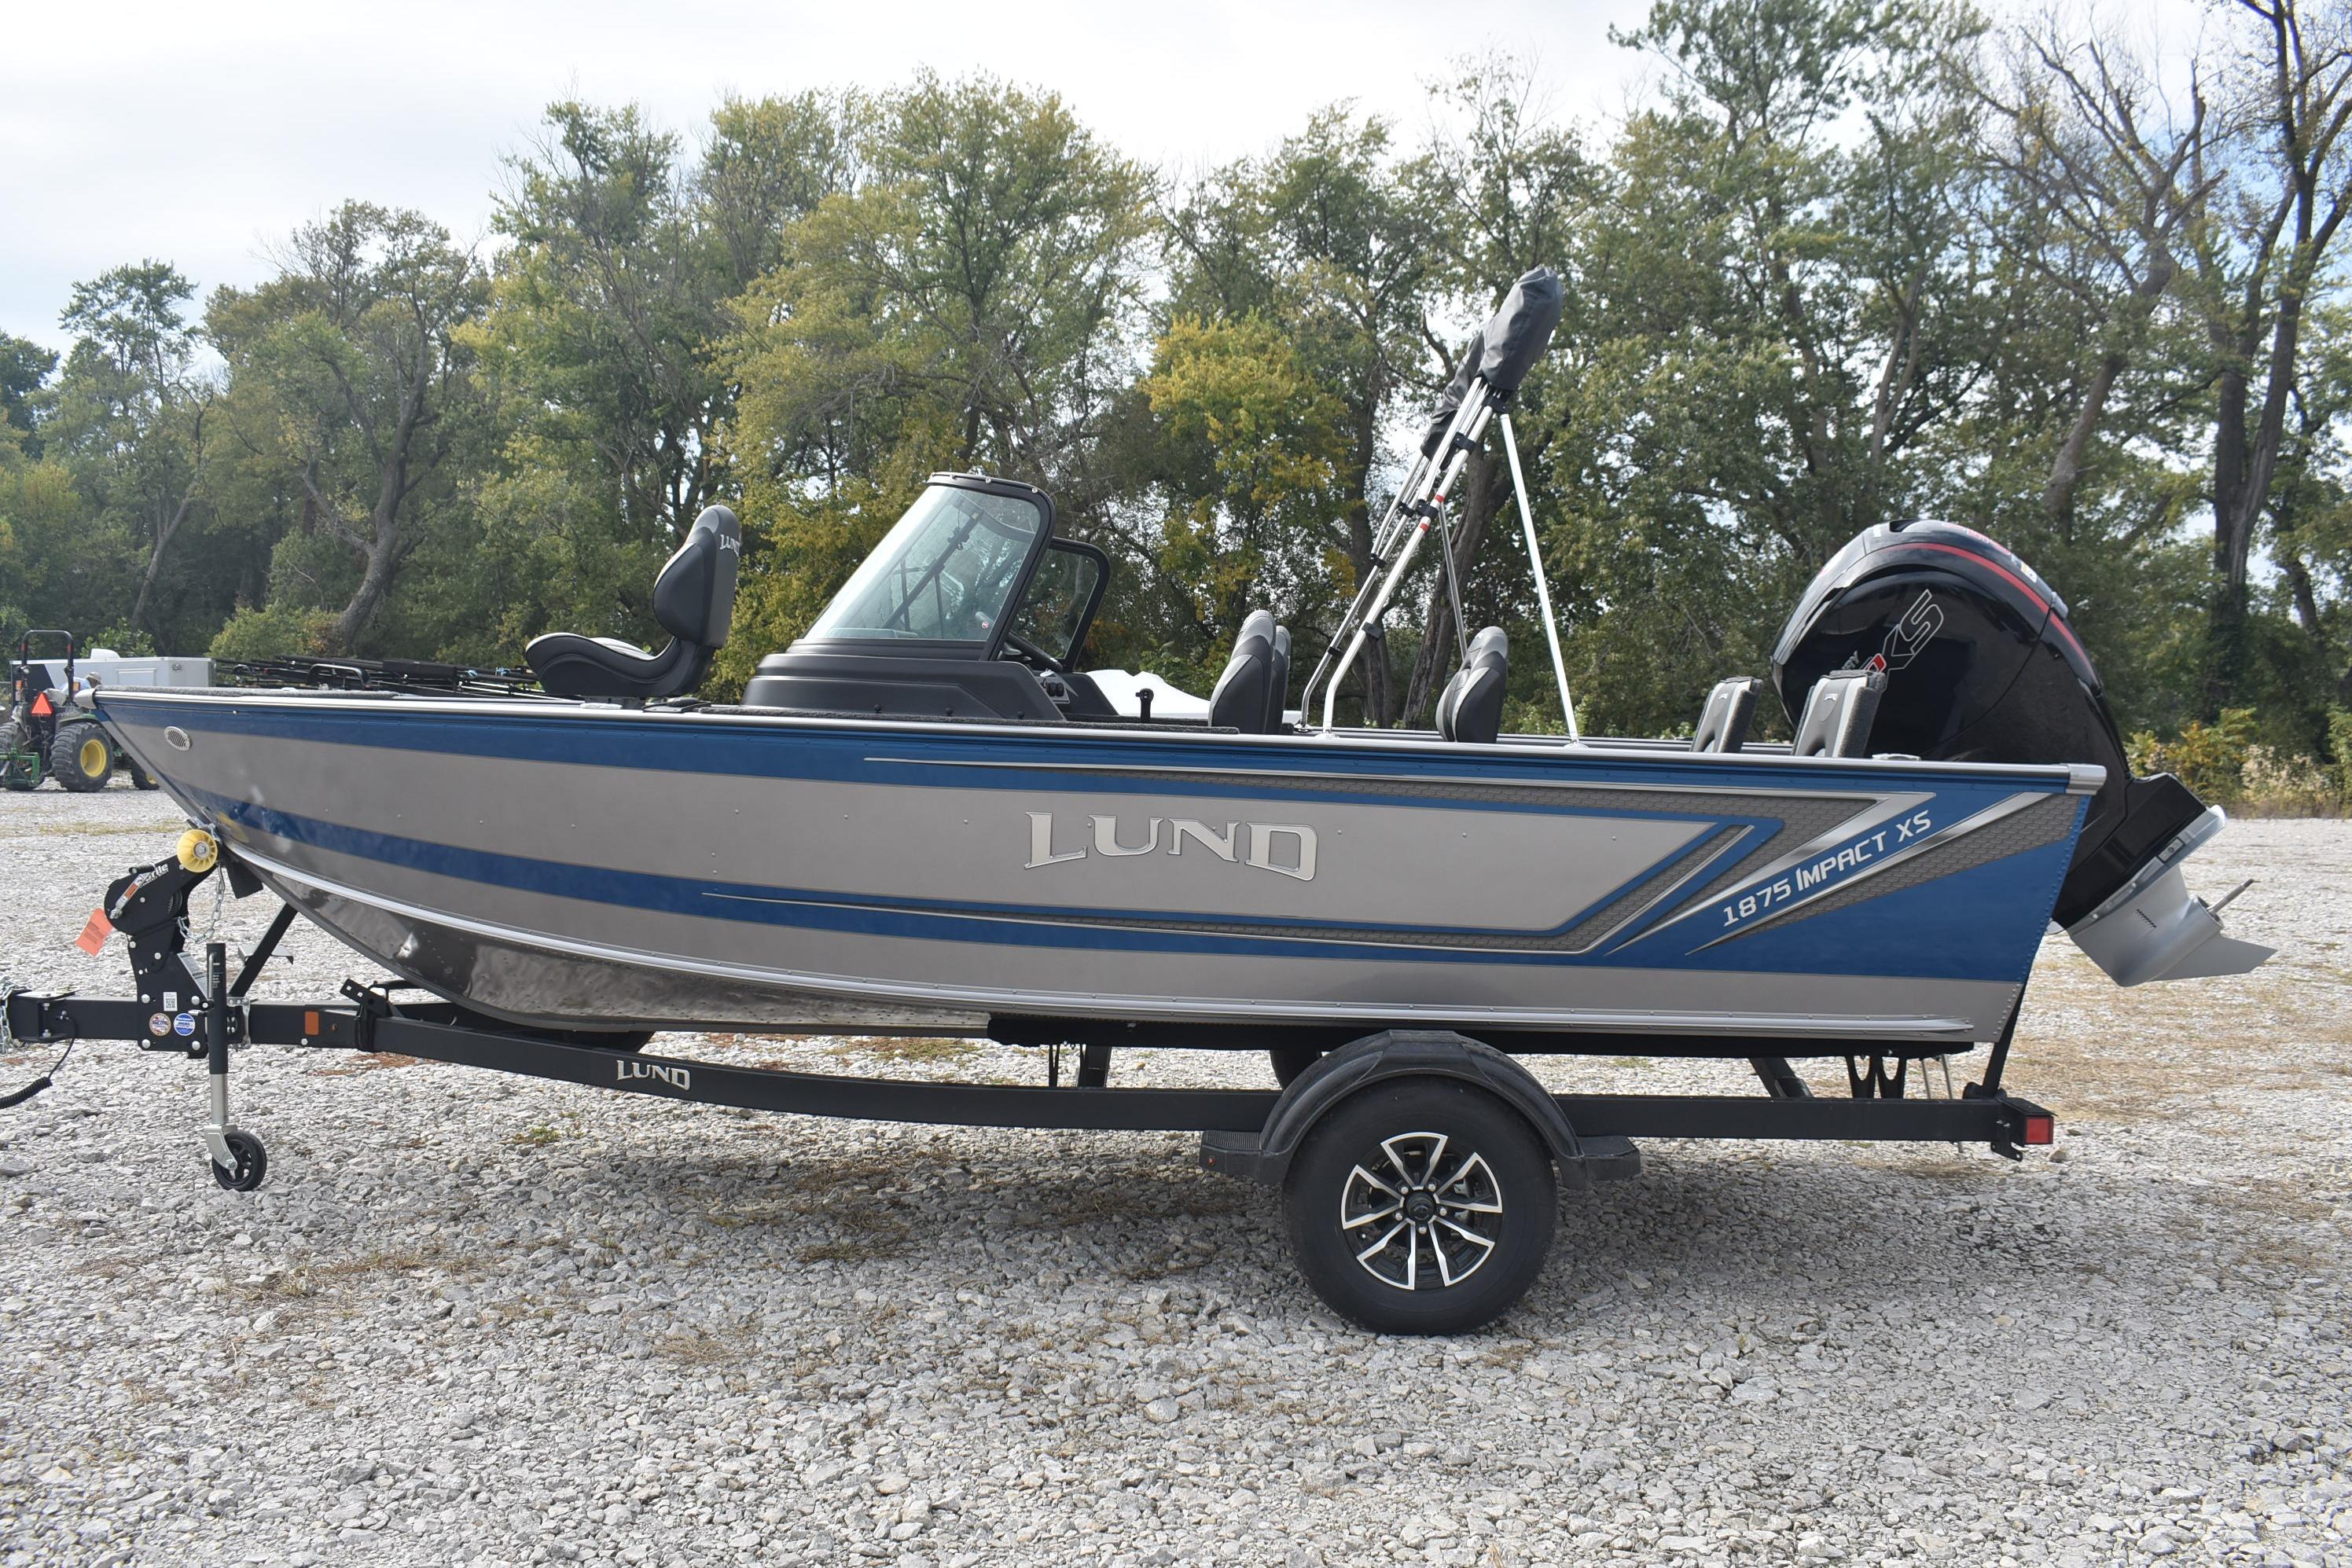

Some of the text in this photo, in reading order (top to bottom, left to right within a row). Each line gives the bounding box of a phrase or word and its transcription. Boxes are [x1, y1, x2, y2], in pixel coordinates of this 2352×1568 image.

[1023, 810, 1318, 882] LUND
[1723, 809, 1932, 927] 1875 IMPACT XS
[616, 1059, 691, 1091] LUND
